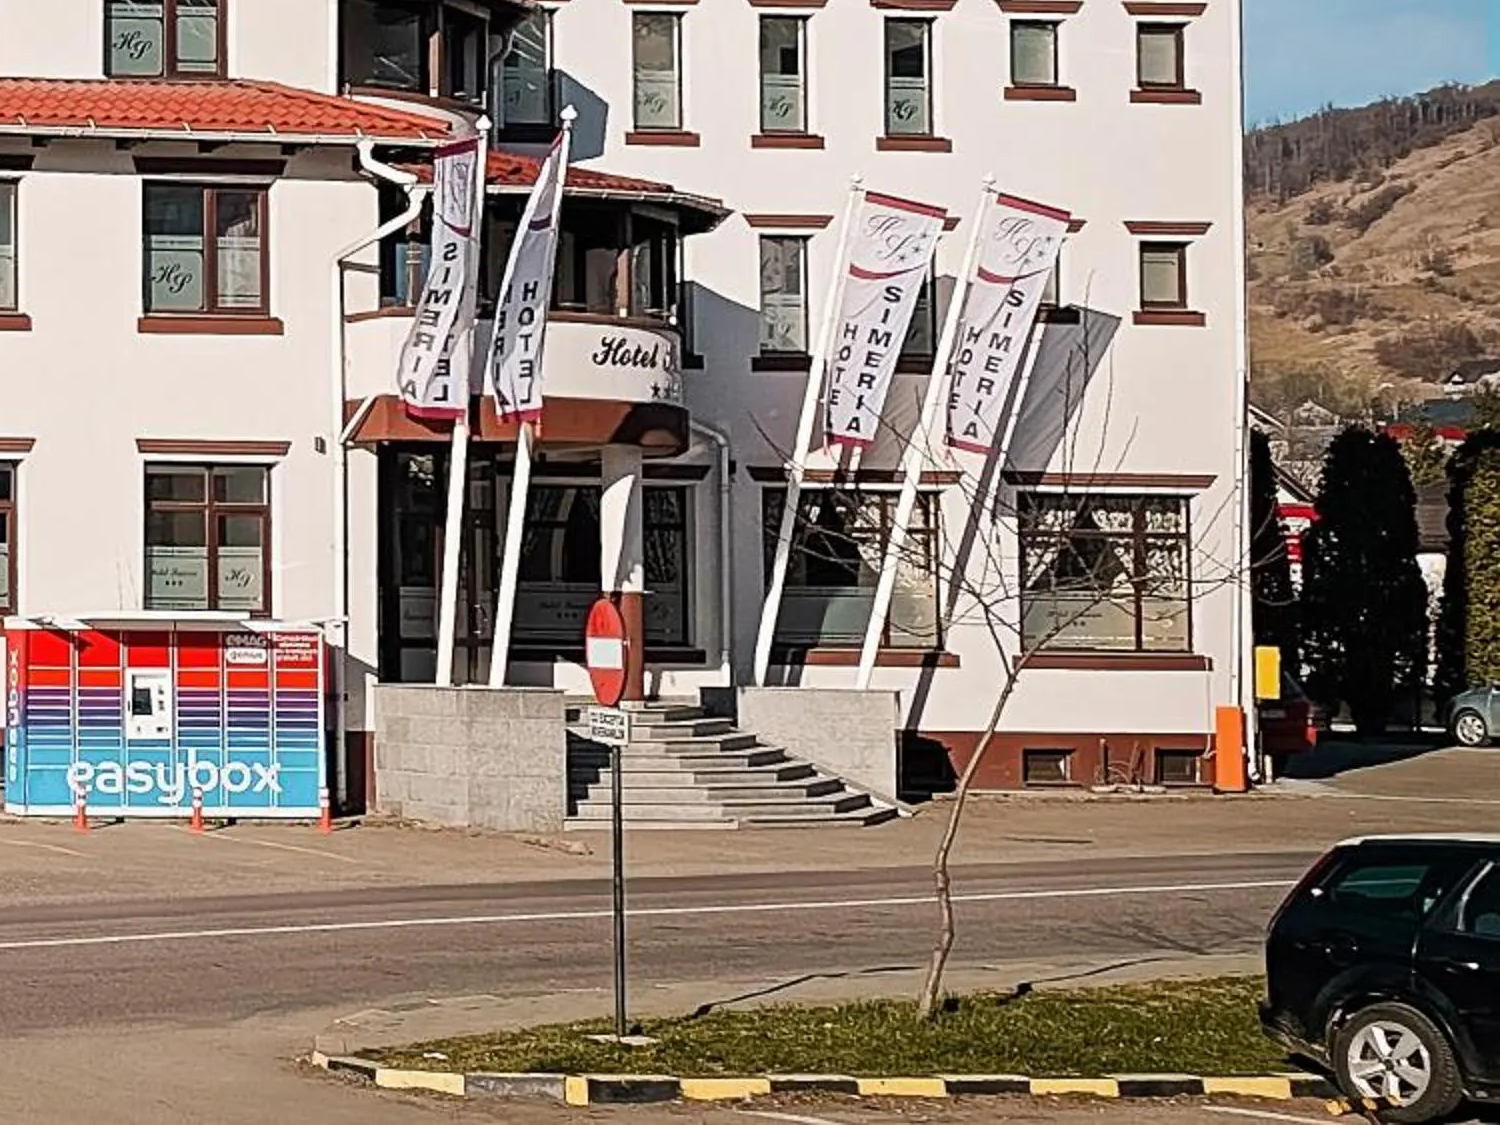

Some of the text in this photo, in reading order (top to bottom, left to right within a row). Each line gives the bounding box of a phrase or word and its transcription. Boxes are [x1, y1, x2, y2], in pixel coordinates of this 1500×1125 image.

[592, 336, 659, 369] Hotel
[845, 286, 903, 433] SIMERIA
[963, 290, 1025, 439] SIMERIA
[67, 747, 283, 804] easybox
